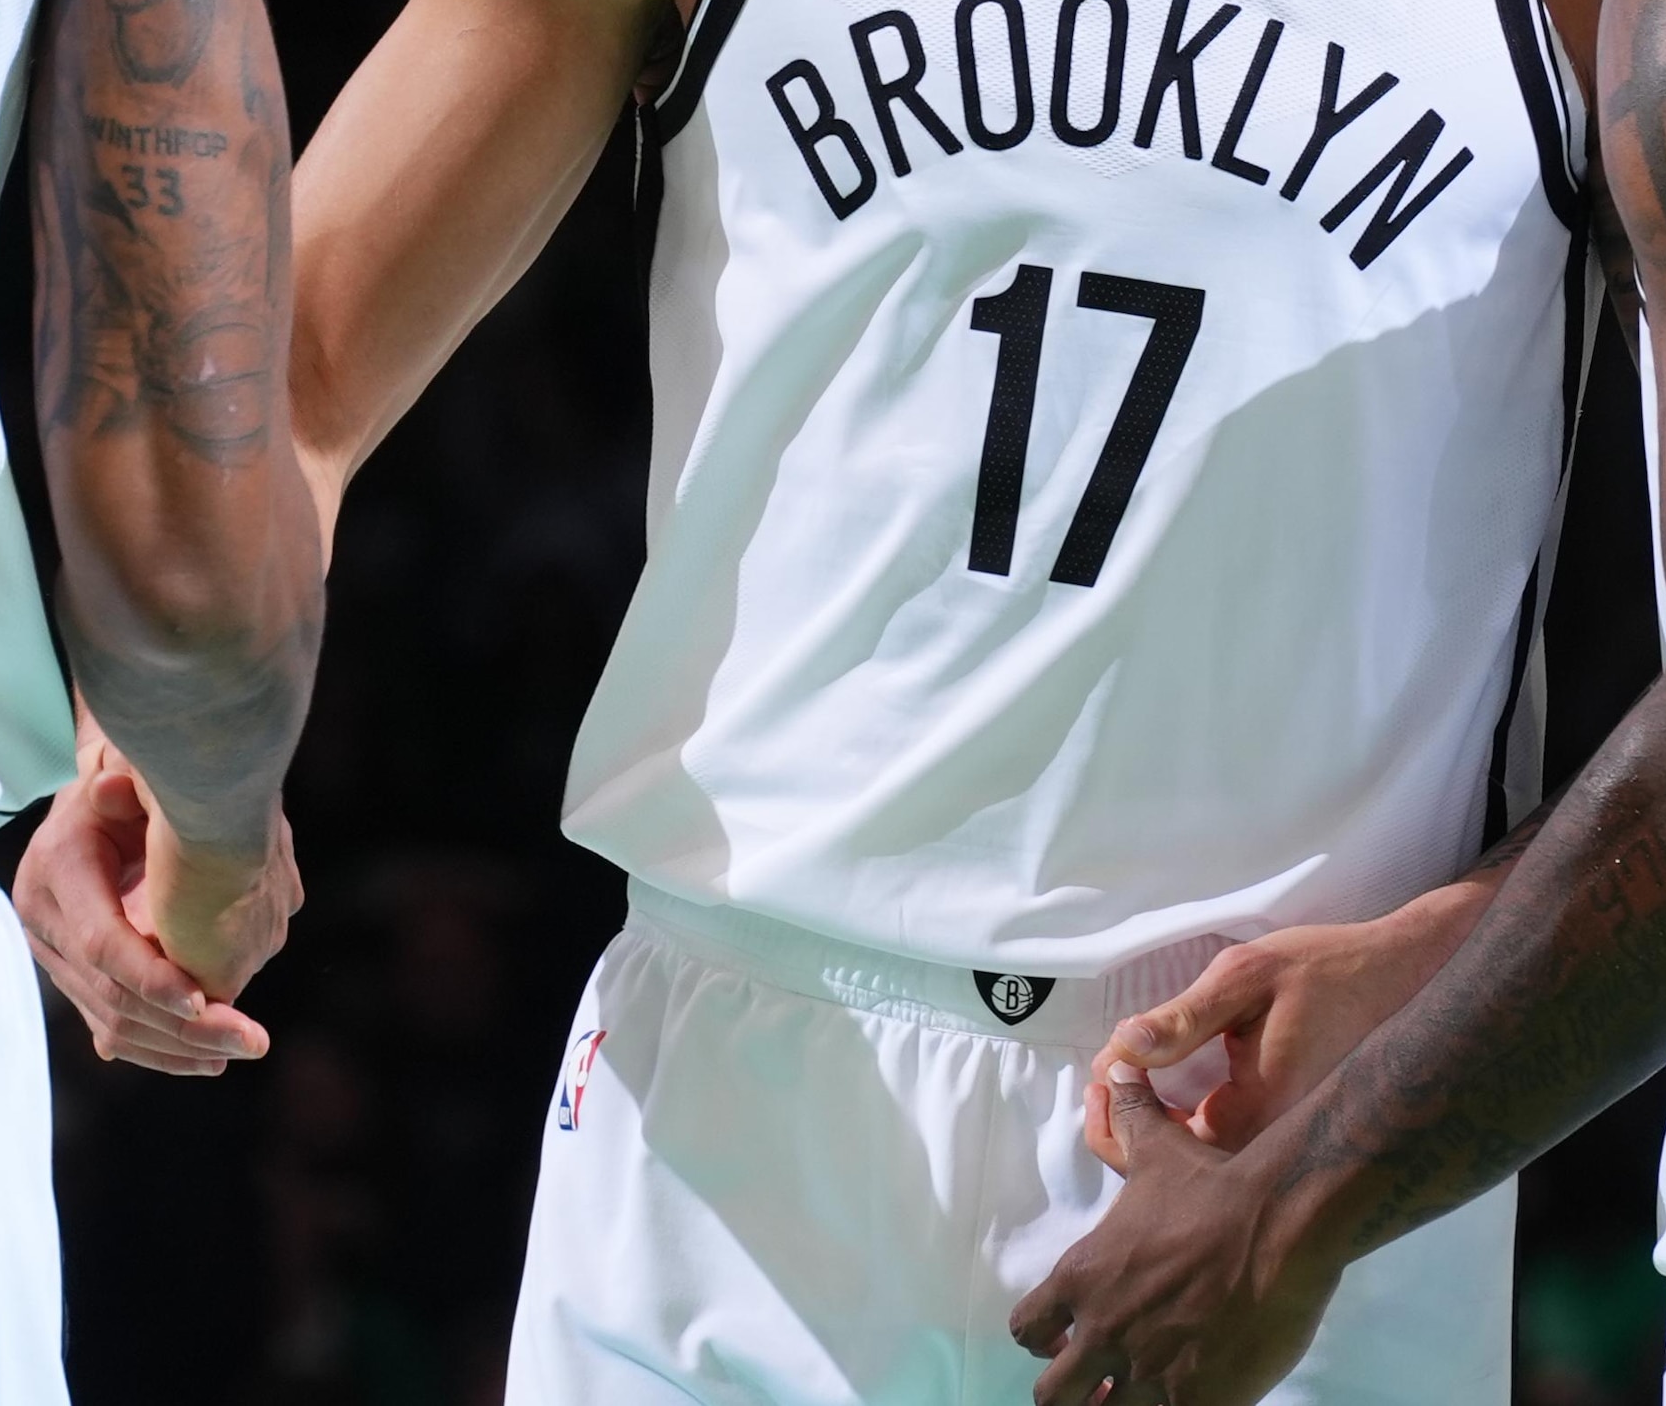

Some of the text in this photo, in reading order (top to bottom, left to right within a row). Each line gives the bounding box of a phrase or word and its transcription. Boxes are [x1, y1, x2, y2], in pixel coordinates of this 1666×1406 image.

[121, 163, 183, 216] 33
[967, 263, 1206, 588] 17
[1005, 980, 1019, 1010] B
